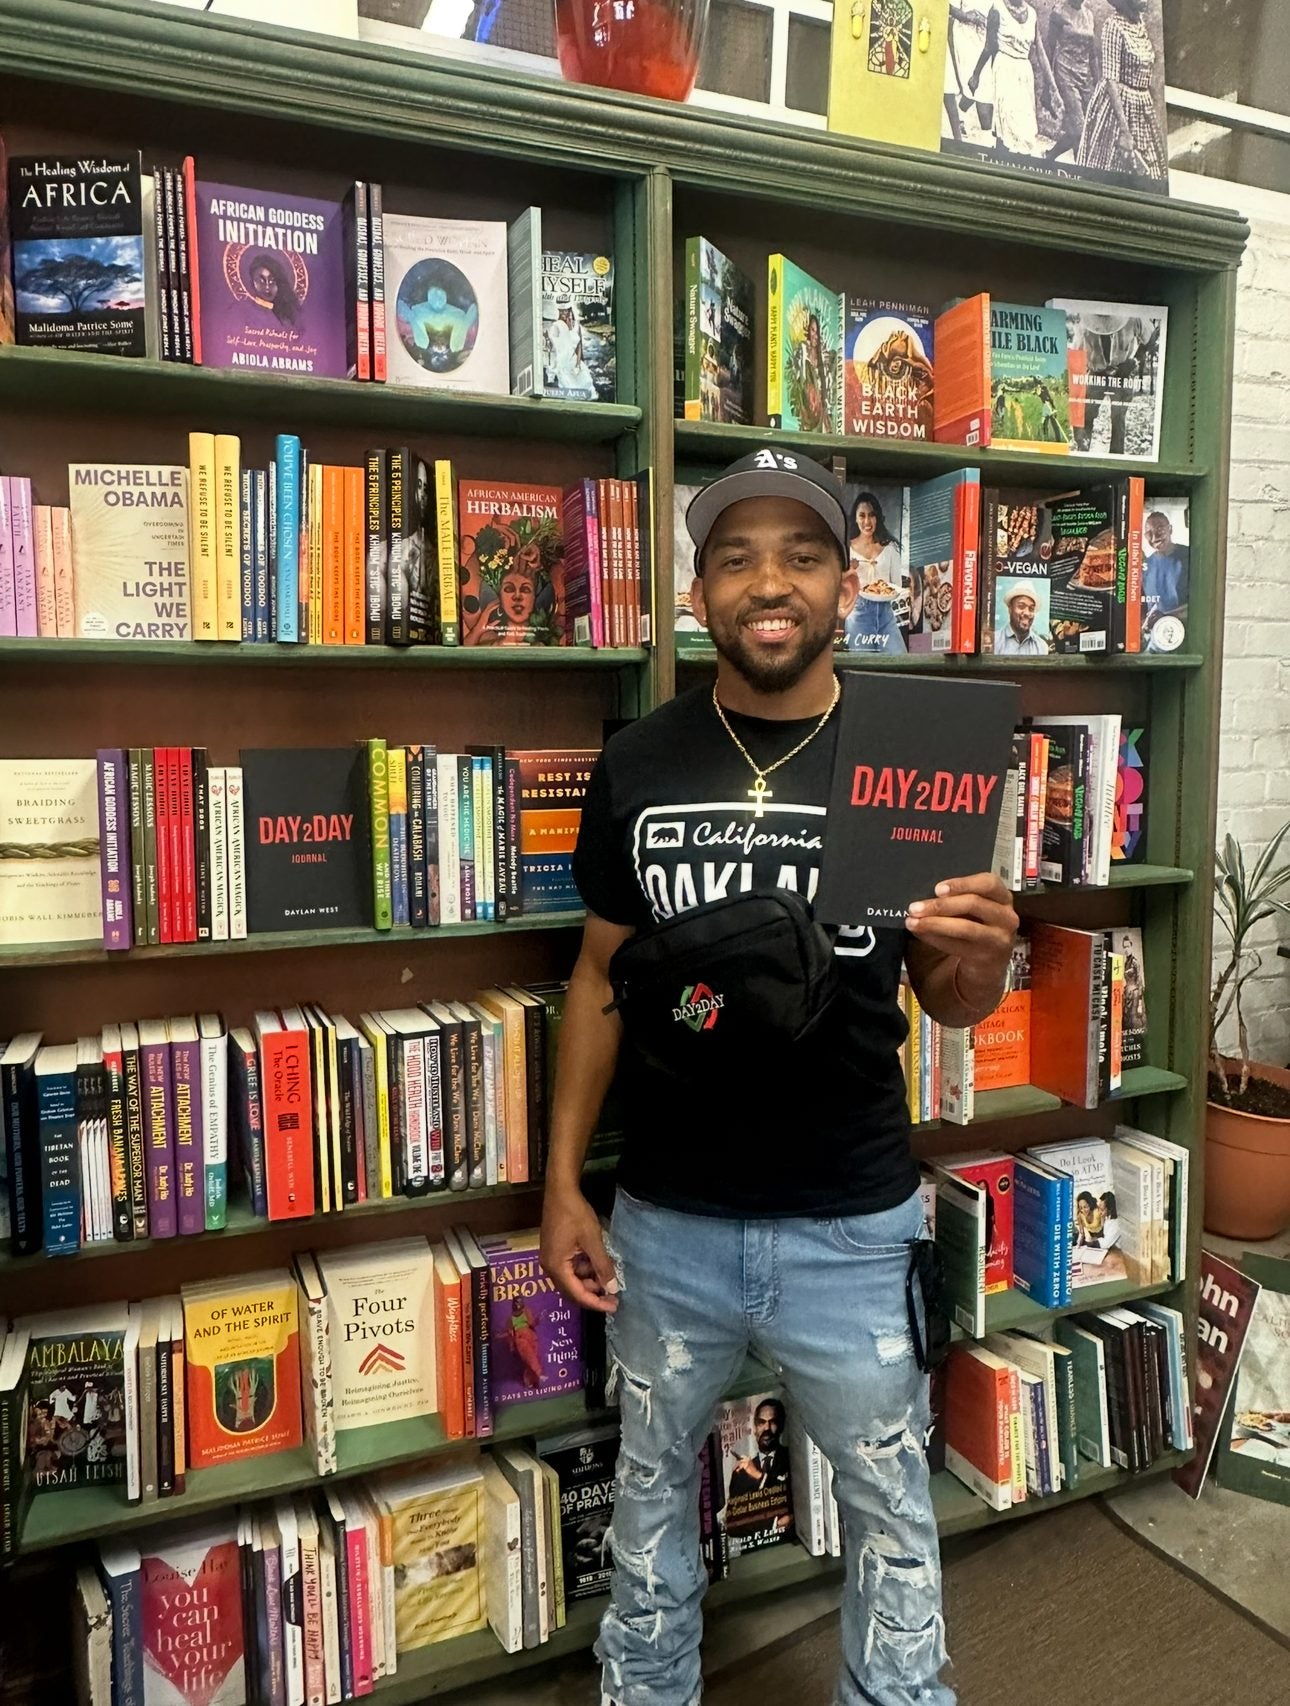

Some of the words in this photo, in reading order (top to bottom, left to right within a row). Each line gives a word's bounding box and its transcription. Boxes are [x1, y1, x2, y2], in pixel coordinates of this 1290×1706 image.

[35, 162, 76, 178] Healing
[78, 159, 121, 175] Wisdom
[22, 180, 131, 208] AFRICA
[210, 199, 265, 222] AFRICAN
[268, 208, 325, 231] GODDESS
[218, 219, 318, 255] INITIATION
[690, 284, 698, 316] Nature
[850, 299, 876, 308] LEAH
[879, 300, 930, 315] PENNIMAN
[29, 321, 74, 333] Malidoma
[77, 320, 108, 331] Patrice
[991, 308, 1042, 332] ARMING
[688, 318, 698, 355] Swagger
[1016, 333, 1059, 355] BLACK
[232, 352, 269, 368] ABIOLA
[272, 356, 314, 372] ABRAMS
[1073, 374, 1106, 386] WORKING
[1108, 376, 1122, 388] THE
[862, 384, 918, 401] BLACK
[862, 402, 918, 417] EARTH
[852, 418, 926, 439] WISDOM
[283, 440, 293, 481] YOU'VE
[391, 454, 401, 471] THE
[754, 449, 798, 469] A's
[75, 469, 182, 486] MICHELLE
[199, 465, 207, 476] WE
[104, 491, 184, 508] OBAMA
[199, 478, 208, 509] REFUSE
[283, 483, 293, 510] BEEN
[391, 479, 402, 529] PRINCIPLES
[467, 488, 509, 499] AFRICAN
[510, 492, 557, 503] AMERICAN
[200, 510, 208, 519] TO
[467, 501, 558, 519] HERBALISM
[200, 520, 208, 531] BE
[283, 512, 293, 560] CHOSEN
[200, 532, 209, 557] SILENT
[392, 532, 402, 565] KHNUM
[144, 562, 185, 577] THE
[995, 561, 1047, 575] O-VEGAN
[122, 581, 187, 598] LIGHT
[154, 602, 187, 618] WE
[392, 592, 402, 620] IBOMU
[115, 622, 188, 639] CARRY
[854, 632, 890, 646] CURRY
[103, 761, 115, 796] AFRICAN
[538, 773, 571, 782] REST
[576, 772, 591, 782] IS
[372, 748, 388, 849] COMMON
[850, 764, 999, 815] DAY2DAY
[16, 799, 76, 807] BRAIDING
[105, 797, 118, 831] GODDESS
[8, 816, 85, 825] SWEETGRASS
[214, 800, 222, 836] AFRICAN
[259, 814, 354, 845] DAY2DAY
[692, 821, 824, 856] California
[890, 826, 944, 844] JOURNAL
[106, 832, 119, 873] INITIATION
[214, 837, 223, 882] AMERICAN
[292, 853, 327, 864] JOURNAL
[375, 863, 383, 876] WE
[498, 862, 506, 894] LAVEAU
[523, 865, 564, 873] TRICIA
[215, 883, 225, 917] MAGICK
[376, 879, 384, 899] RISE
[284, 908, 316, 916] DAYLAN
[319, 906, 339, 914] WEST
[1094, 943, 1102, 955] TU
[1093, 957, 1102, 981] CASA
[1092, 983, 1101, 992] MI
[672, 994, 726, 1022] DAY2DAY
[1091, 997, 1100, 1021] CASA
[450, 1033, 457, 1047] We
[126, 1055, 136, 1073] THE
[208, 1044, 218, 1062] The
[273, 1050, 283, 1070] The
[450, 1048, 459, 1064] Live
[208, 1064, 218, 1097] Genius
[247, 1058, 258, 1089] GRIEF
[285, 1054, 301, 1104] CHING
[127, 1074, 137, 1096] WAY
[249, 1090, 258, 1100] IS
[273, 1071, 285, 1102] Oracle
[128, 1097, 138, 1112] OF
[209, 1099, 218, 1109] of
[452, 1090, 460, 1104] We
[129, 1114, 139, 1131] THE
[150, 1086, 167, 1150] ATTACHMENT
[176, 1083, 193, 1147] ATTACHMENT
[250, 1103, 260, 1131] LOVE
[209, 1111, 220, 1160] EMPATHY
[130, 1132, 143, 1179] SUPERIOR
[134, 1179, 144, 1202] MAN
[1053, 1224, 1061, 1240] DIE
[1053, 1242, 1061, 1270] WITH
[479, 1271, 488, 1300] briefly
[1052, 1271, 1060, 1298] ZERO
[211, 1308, 227, 1321] OF
[231, 1301, 274, 1316] WATER
[352, 1297, 407, 1317] Four
[549, 1310, 570, 1323] Did
[193, 1324, 221, 1339] AND
[224, 1319, 250, 1333] THE
[253, 1312, 292, 1328] SPIRIT
[316, 1309, 324, 1332] BRAVE
[343, 1318, 415, 1342] Pivots
[446, 1297, 460, 1343] Weightless
[479, 1302, 488, 1341] perfectly
[30, 1338, 123, 1367] AMBALAYA
[317, 1334, 325, 1365] ENOUGH
[549, 1337, 574, 1352] New
[481, 1343, 489, 1375] human
[547, 1347, 578, 1365] Thing
[318, 1367, 325, 1377] TO
[319, 1377, 326, 1388] BE
[341, 1393, 388, 1406] Reimagining
[388, 1387, 424, 1398] Ourselves
[345, 1382, 391, 1395] Reimagining
[561, 1490, 578, 1505] 40
[581, 1480, 617, 1500] DAYS
[576, 1492, 616, 1513] PRAYE
[304, 1547, 317, 1575] THINK
[158, 1587, 208, 1619] you
[172, 1605, 219, 1628] can
[308, 1612, 318, 1626] BE
[157, 1619, 212, 1652] heal
[307, 1629, 320, 1660] HAPPY
[168, 1640, 233, 1678] your
[183, 1663, 224, 1694] life
